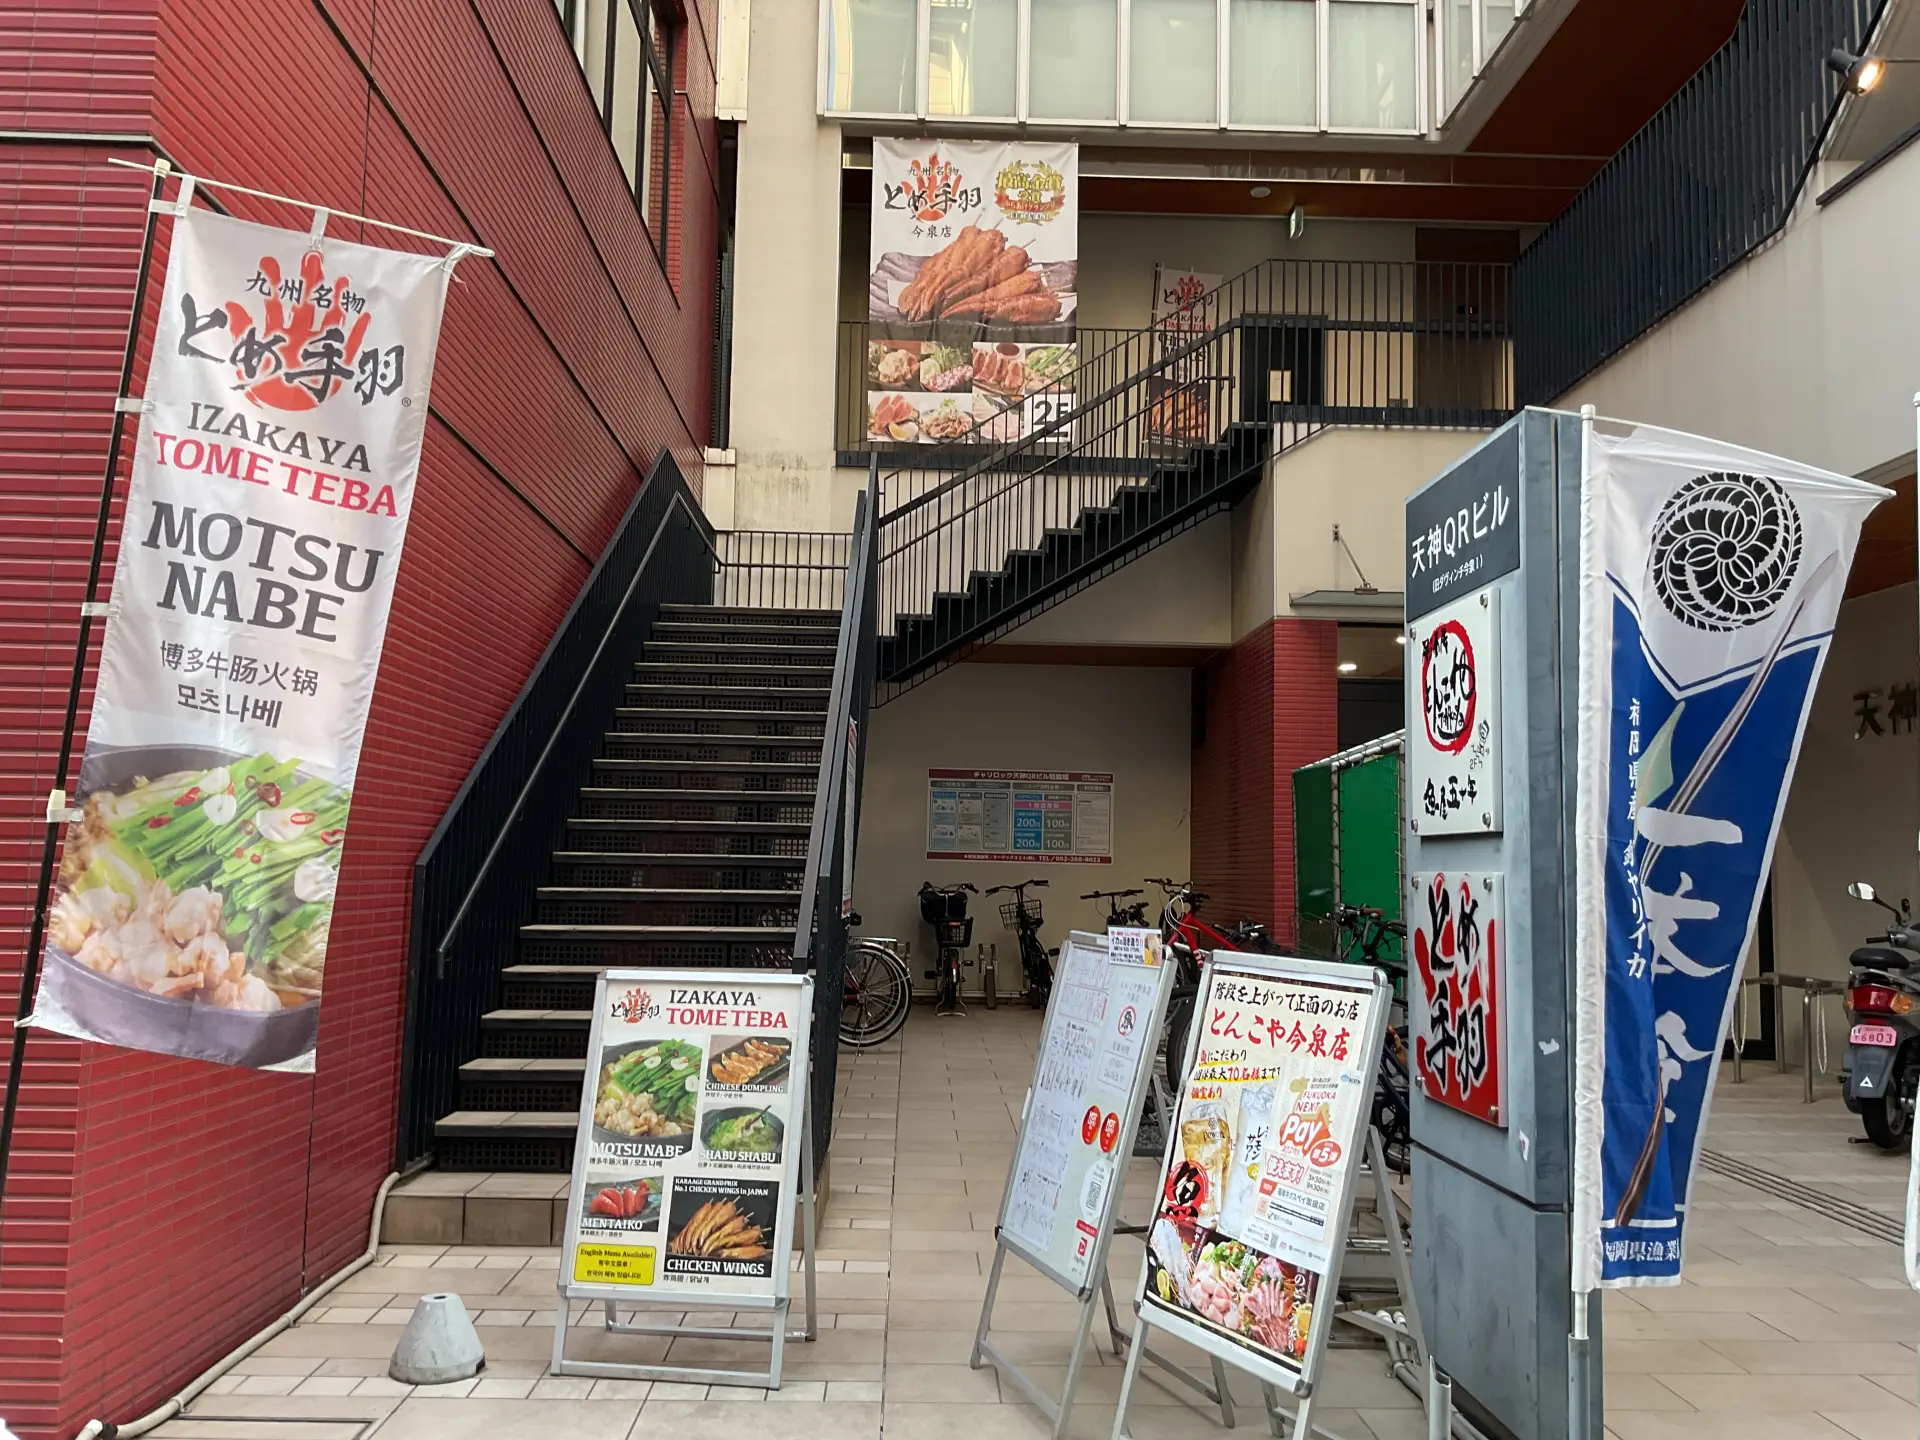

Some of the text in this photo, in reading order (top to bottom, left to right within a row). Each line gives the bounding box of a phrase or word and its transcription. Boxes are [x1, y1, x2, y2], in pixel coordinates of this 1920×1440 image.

[907, 166, 960, 176] 九州名物
[884, 182, 982, 219] とめ手羽
[912, 225, 952, 238] 今泉店
[246, 271, 366, 314] 九州名物
[177, 292, 405, 407] とめ手羽
[187, 402, 372, 474] IZAKAYA
[141, 500, 385, 595] MOTSU
[1411, 484, 1509, 578] 天神QRビル
[156, 560, 345, 643] NABE
[160, 641, 319, 697] 博多牛肠火锅
[1853, 683, 1918, 740] 天神
[669, 989, 756, 1006] IZAKAYA
[1214, 981, 1360, 1021] 階段を上がって正面のお店
[1210, 1007, 1350, 1061] とんこや今泉店
[706, 1082, 784, 1093] CHINESE DUMPLING
[1303, 1091, 1337, 1100] FUKUOKA
[1296, 1102, 1320, 1113] NEXT
[593, 1142, 684, 1158] MOTSU NABE
[1281, 1114, 1323, 1151] Pay
[700, 1149, 776, 1162] SHABU SHABU
[580, 1218, 643, 1230] MENTAIKO
[580, 1249, 603, 1257] English
[666, 1259, 765, 1275] CHICKEN WINGS
